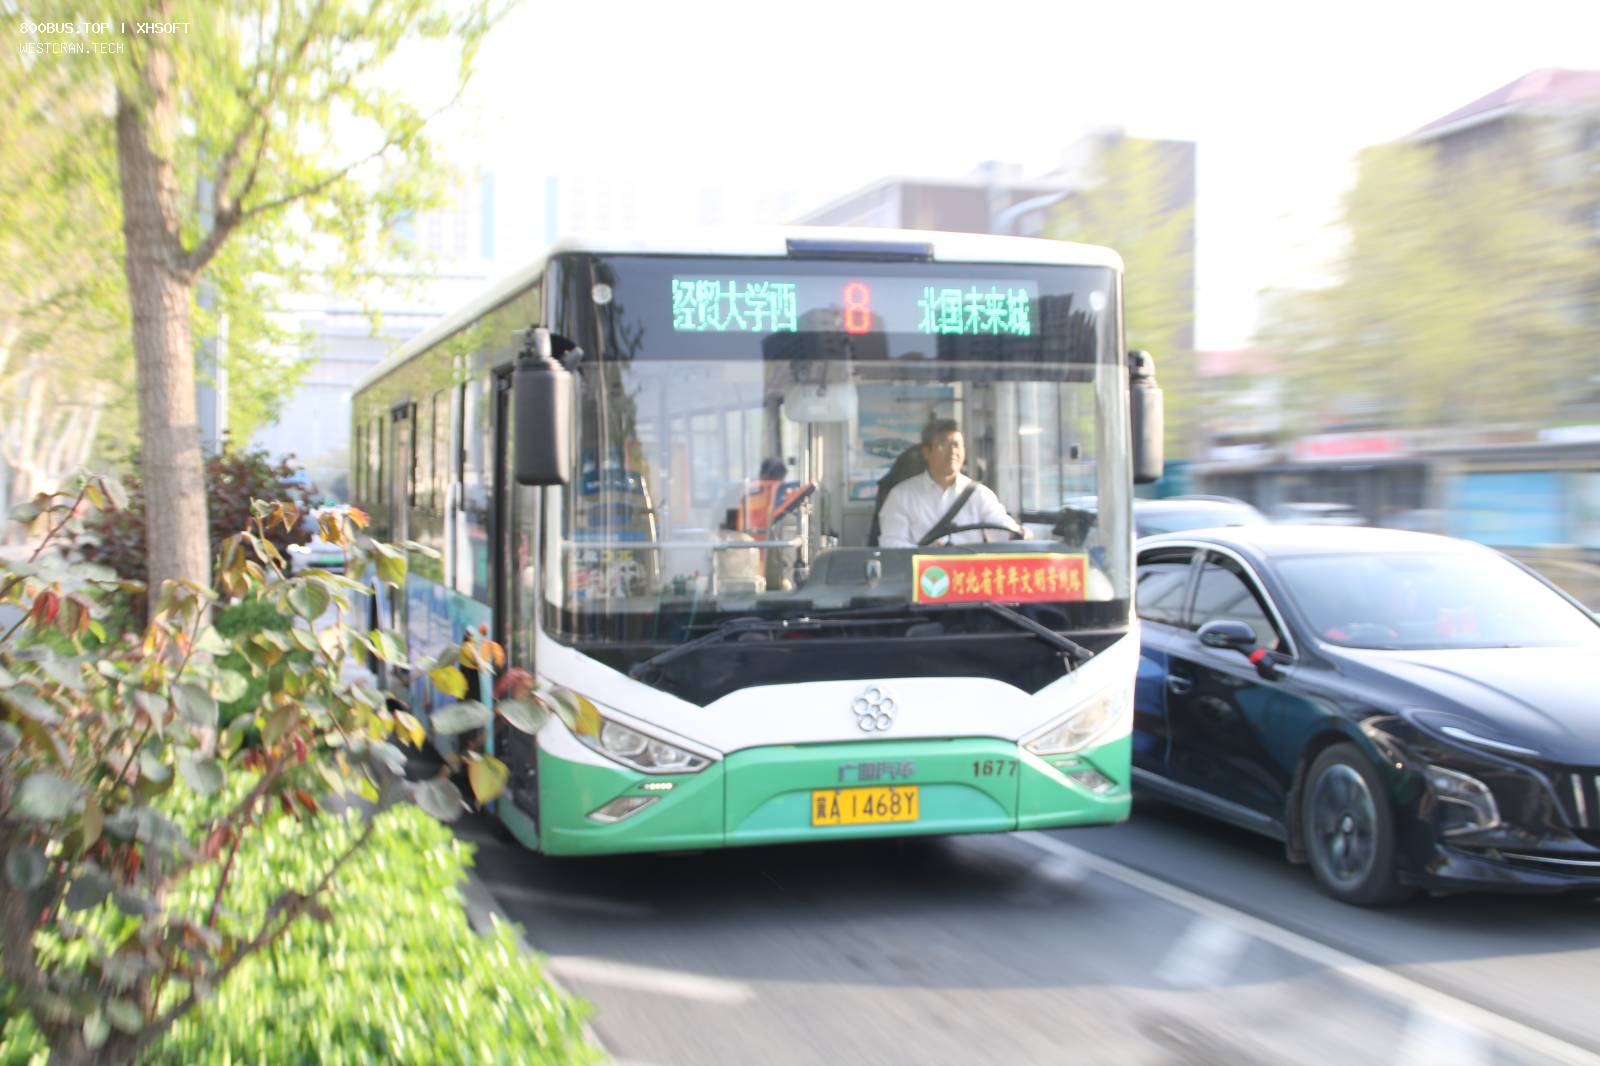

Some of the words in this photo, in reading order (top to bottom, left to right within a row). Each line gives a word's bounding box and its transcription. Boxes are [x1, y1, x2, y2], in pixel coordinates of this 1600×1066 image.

[672, 279, 797, 332] 经贸大学西
[844, 282, 871, 334] 8
[918, 286, 1031, 336] 北国未来城
[972, 760, 1017, 777] 1677
